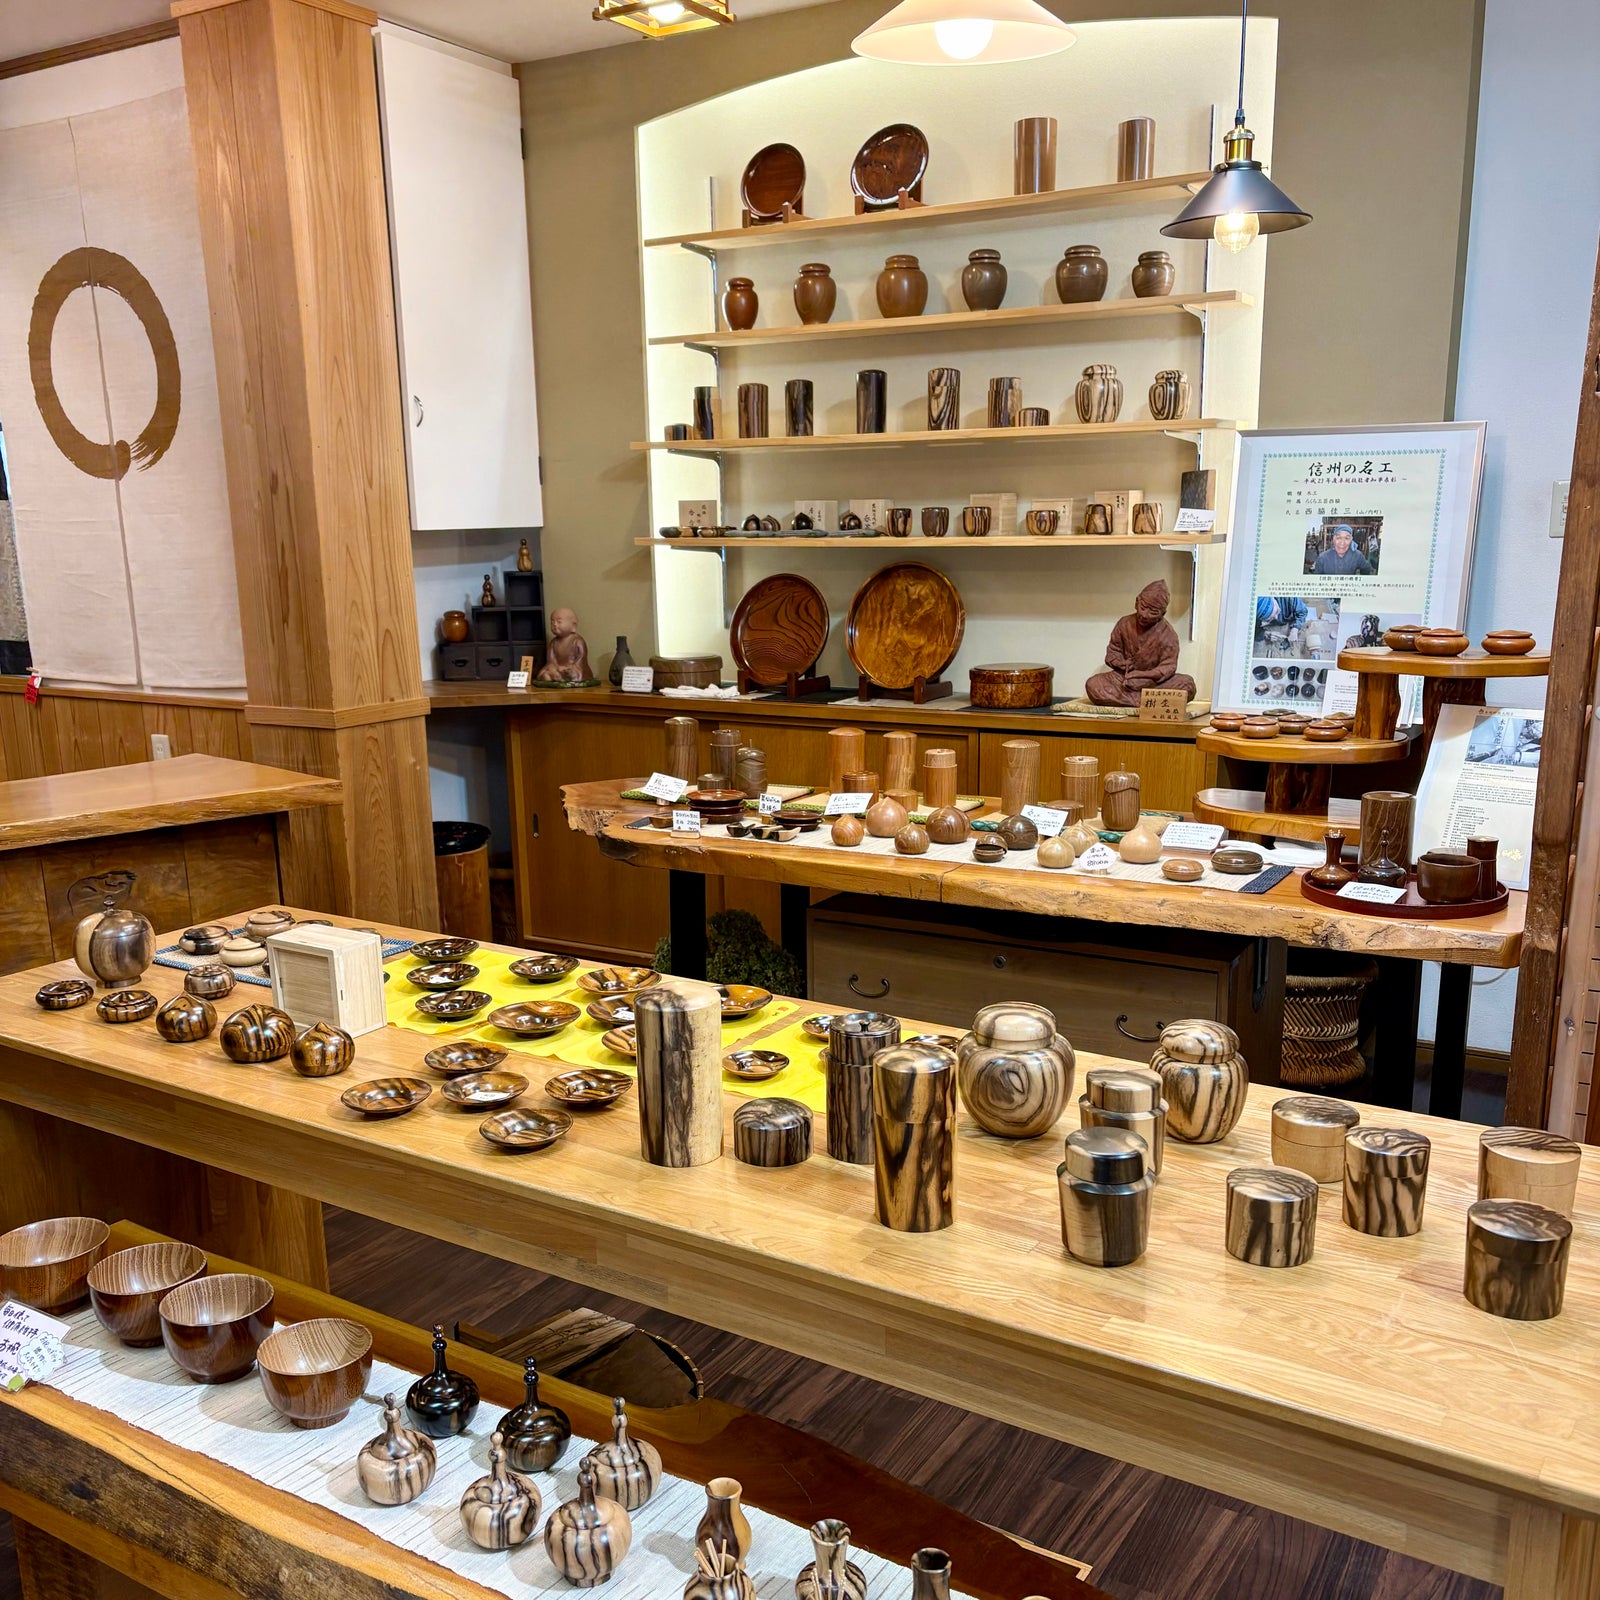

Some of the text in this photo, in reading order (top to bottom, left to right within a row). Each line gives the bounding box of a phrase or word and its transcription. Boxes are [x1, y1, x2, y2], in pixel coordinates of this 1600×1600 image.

[1309, 460, 1393, 477] 信州の名工
